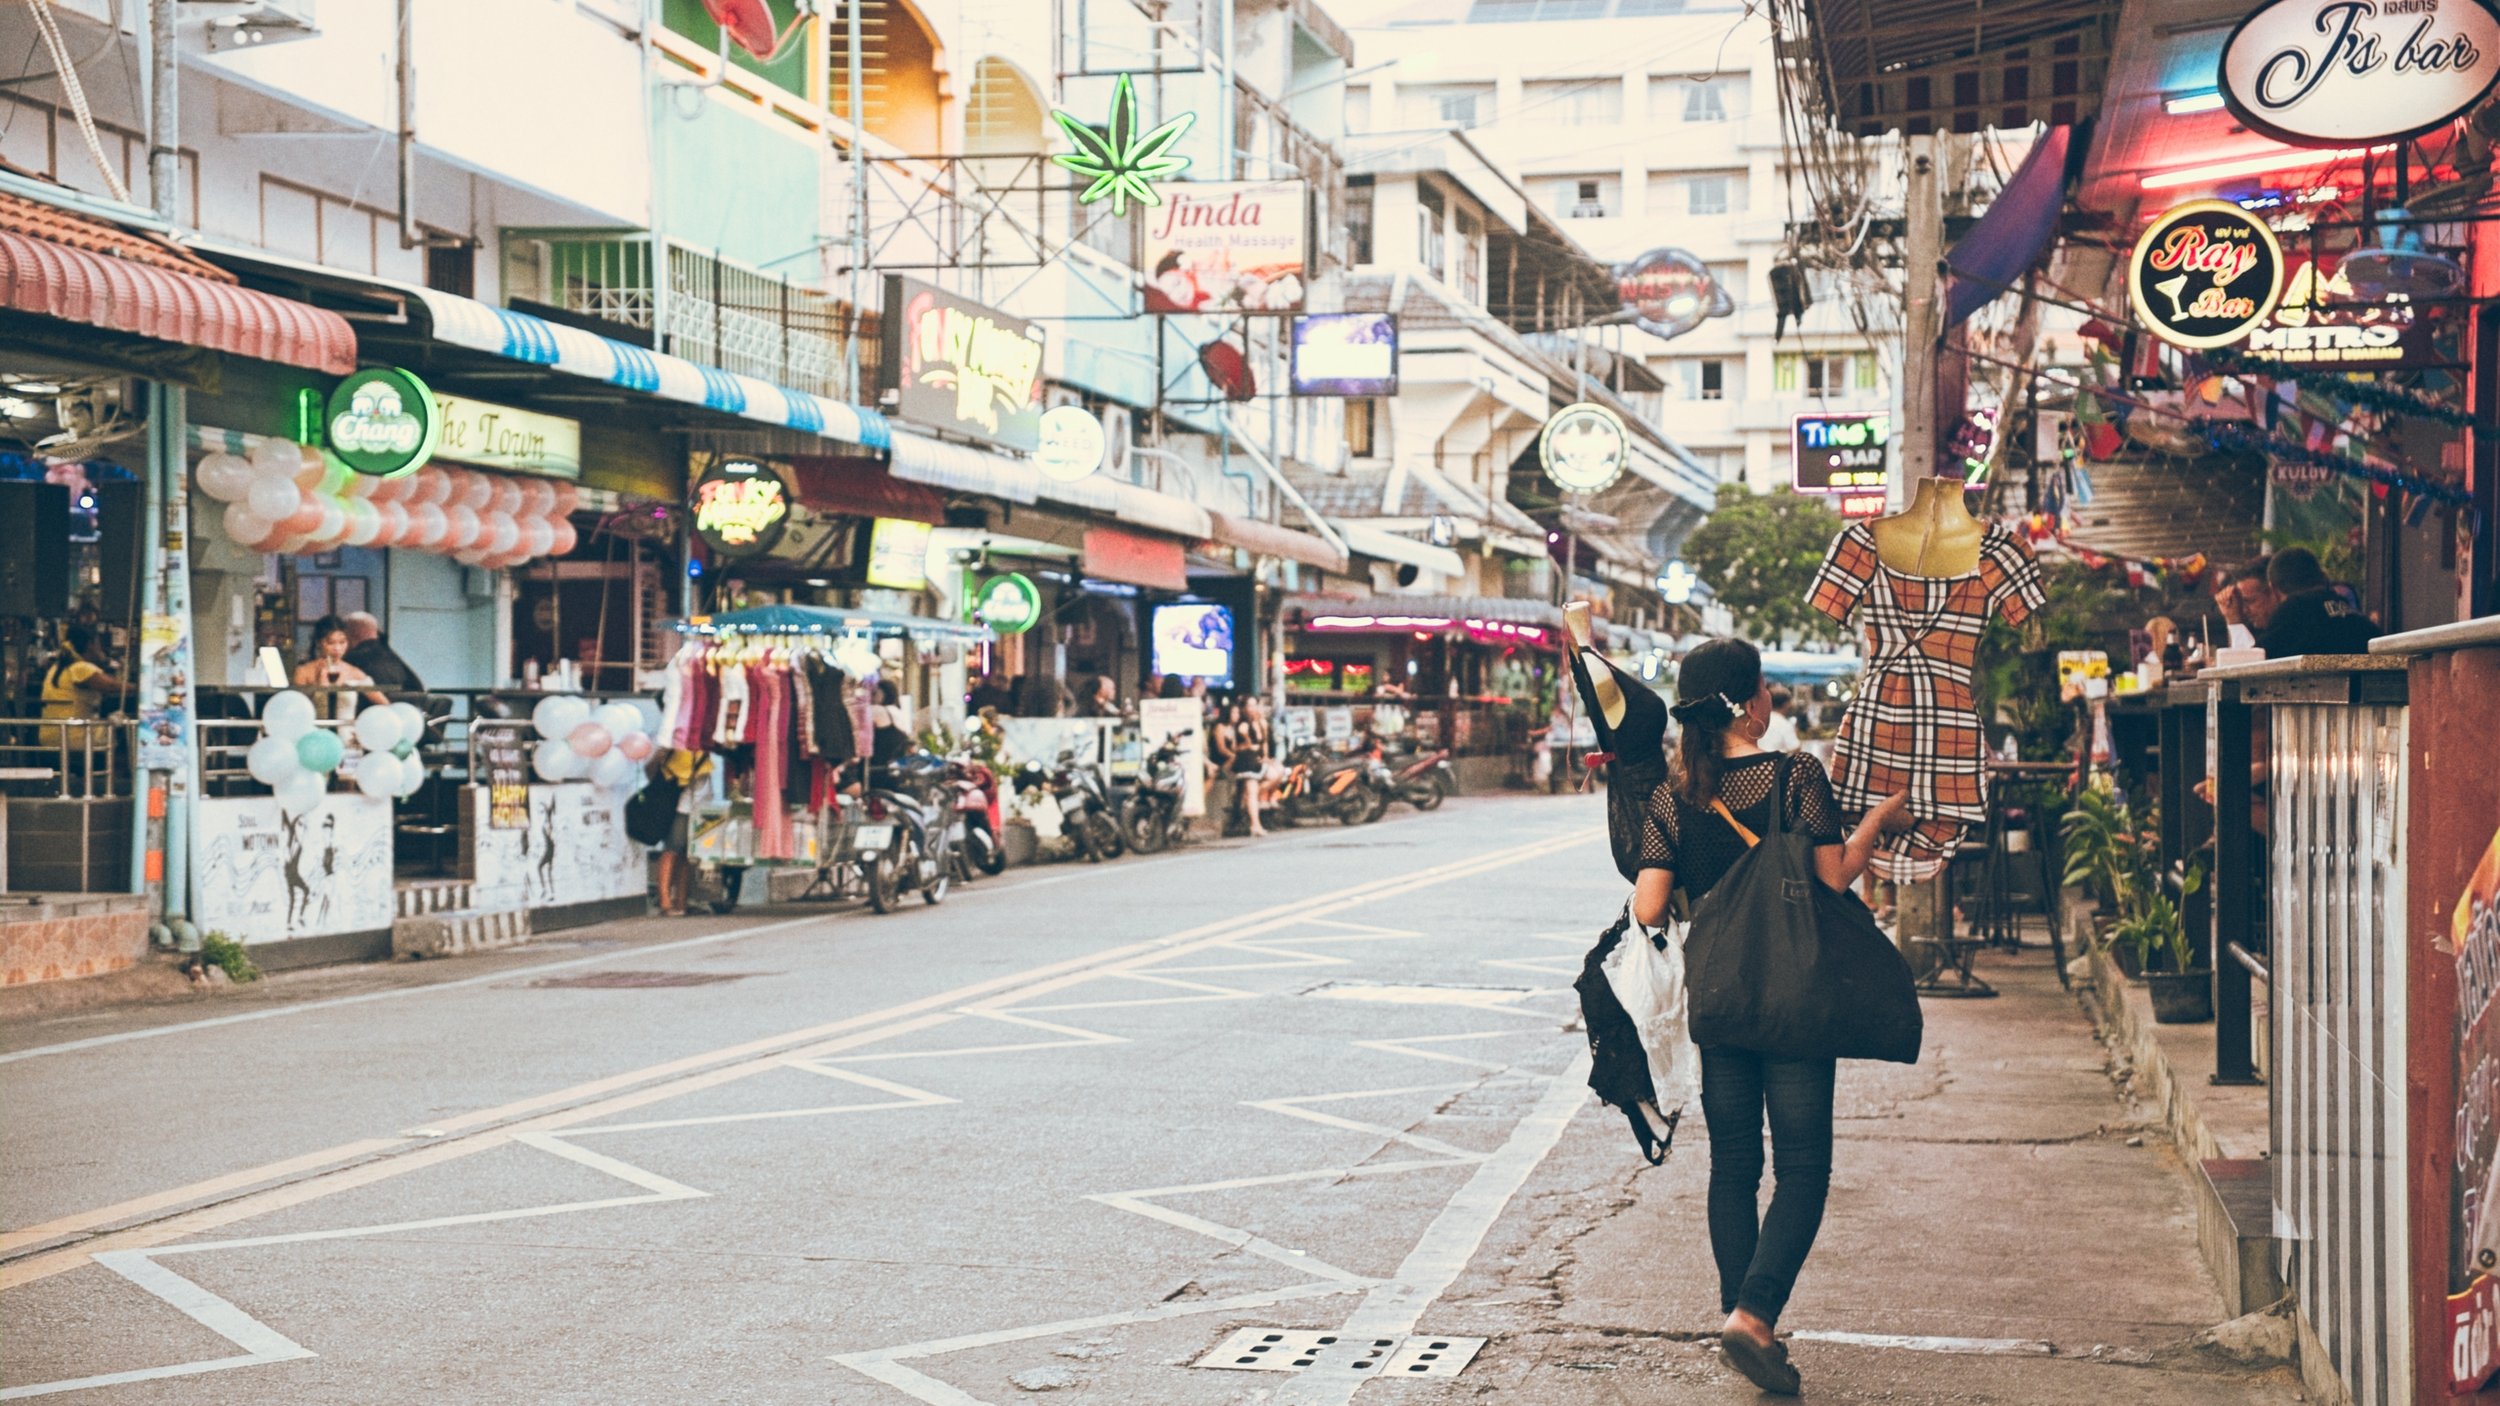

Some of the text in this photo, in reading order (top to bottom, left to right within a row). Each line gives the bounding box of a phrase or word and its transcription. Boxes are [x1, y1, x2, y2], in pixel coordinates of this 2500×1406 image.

[2393, 15, 2480, 73] bar
[1153, 191, 1262, 240] Jinda
[1175, 234, 1296, 250] Health Massage
[2150, 224, 2257, 287] Ray
[2188, 286, 2254, 319] Bar
[2250, 325, 2400, 350] METRO
[335, 416, 416, 446] Chang
[437, 400, 545, 461] he Town
[1841, 449, 1882, 467] BAR
